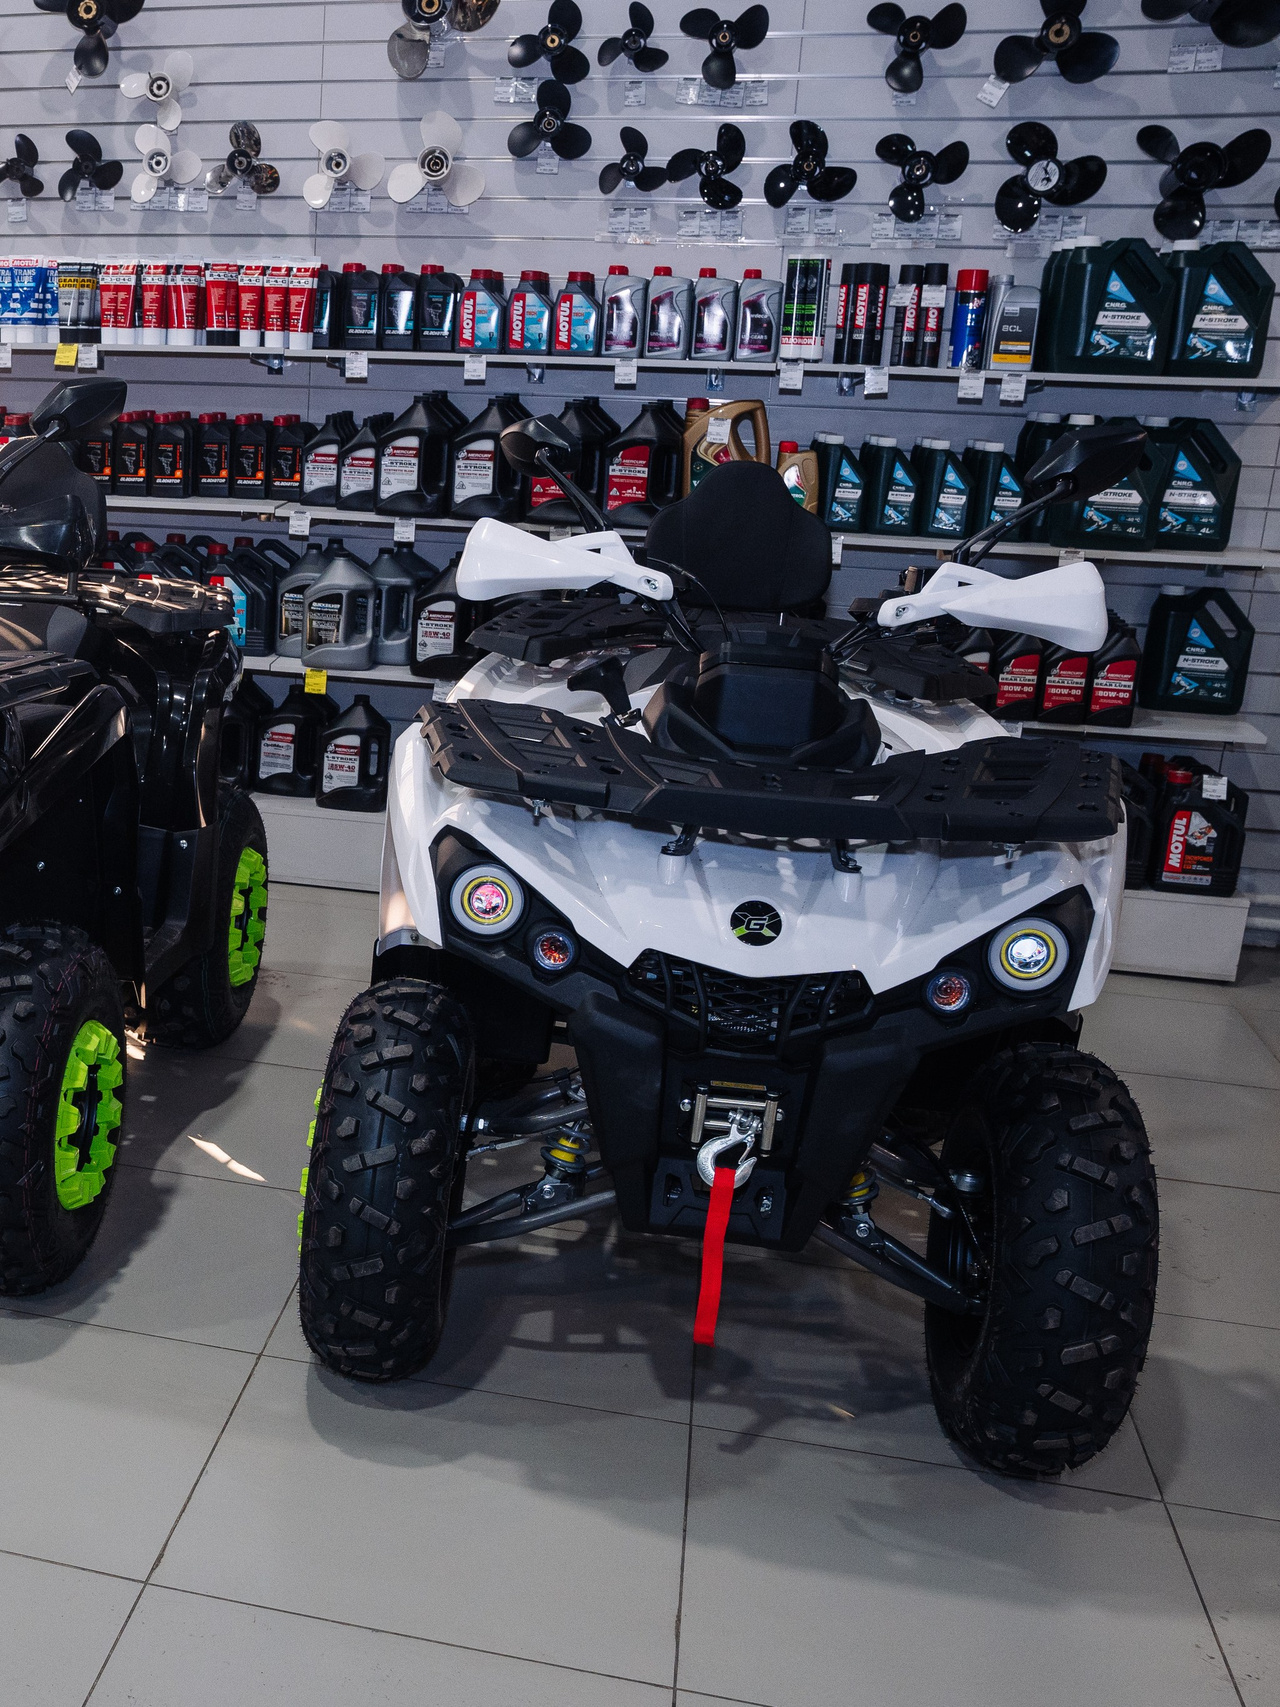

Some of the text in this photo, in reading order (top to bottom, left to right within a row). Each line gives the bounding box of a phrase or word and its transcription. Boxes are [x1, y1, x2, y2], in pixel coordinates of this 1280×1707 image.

[463, 299, 473, 340] MOTUL
[513, 300, 523, 341] MOTUL
[559, 301, 570, 343] MOTUL
[837, 286, 846, 326] MOTUL
[855, 286, 867, 327] MOTUL
[1168, 818, 1187, 867] MOTUL
